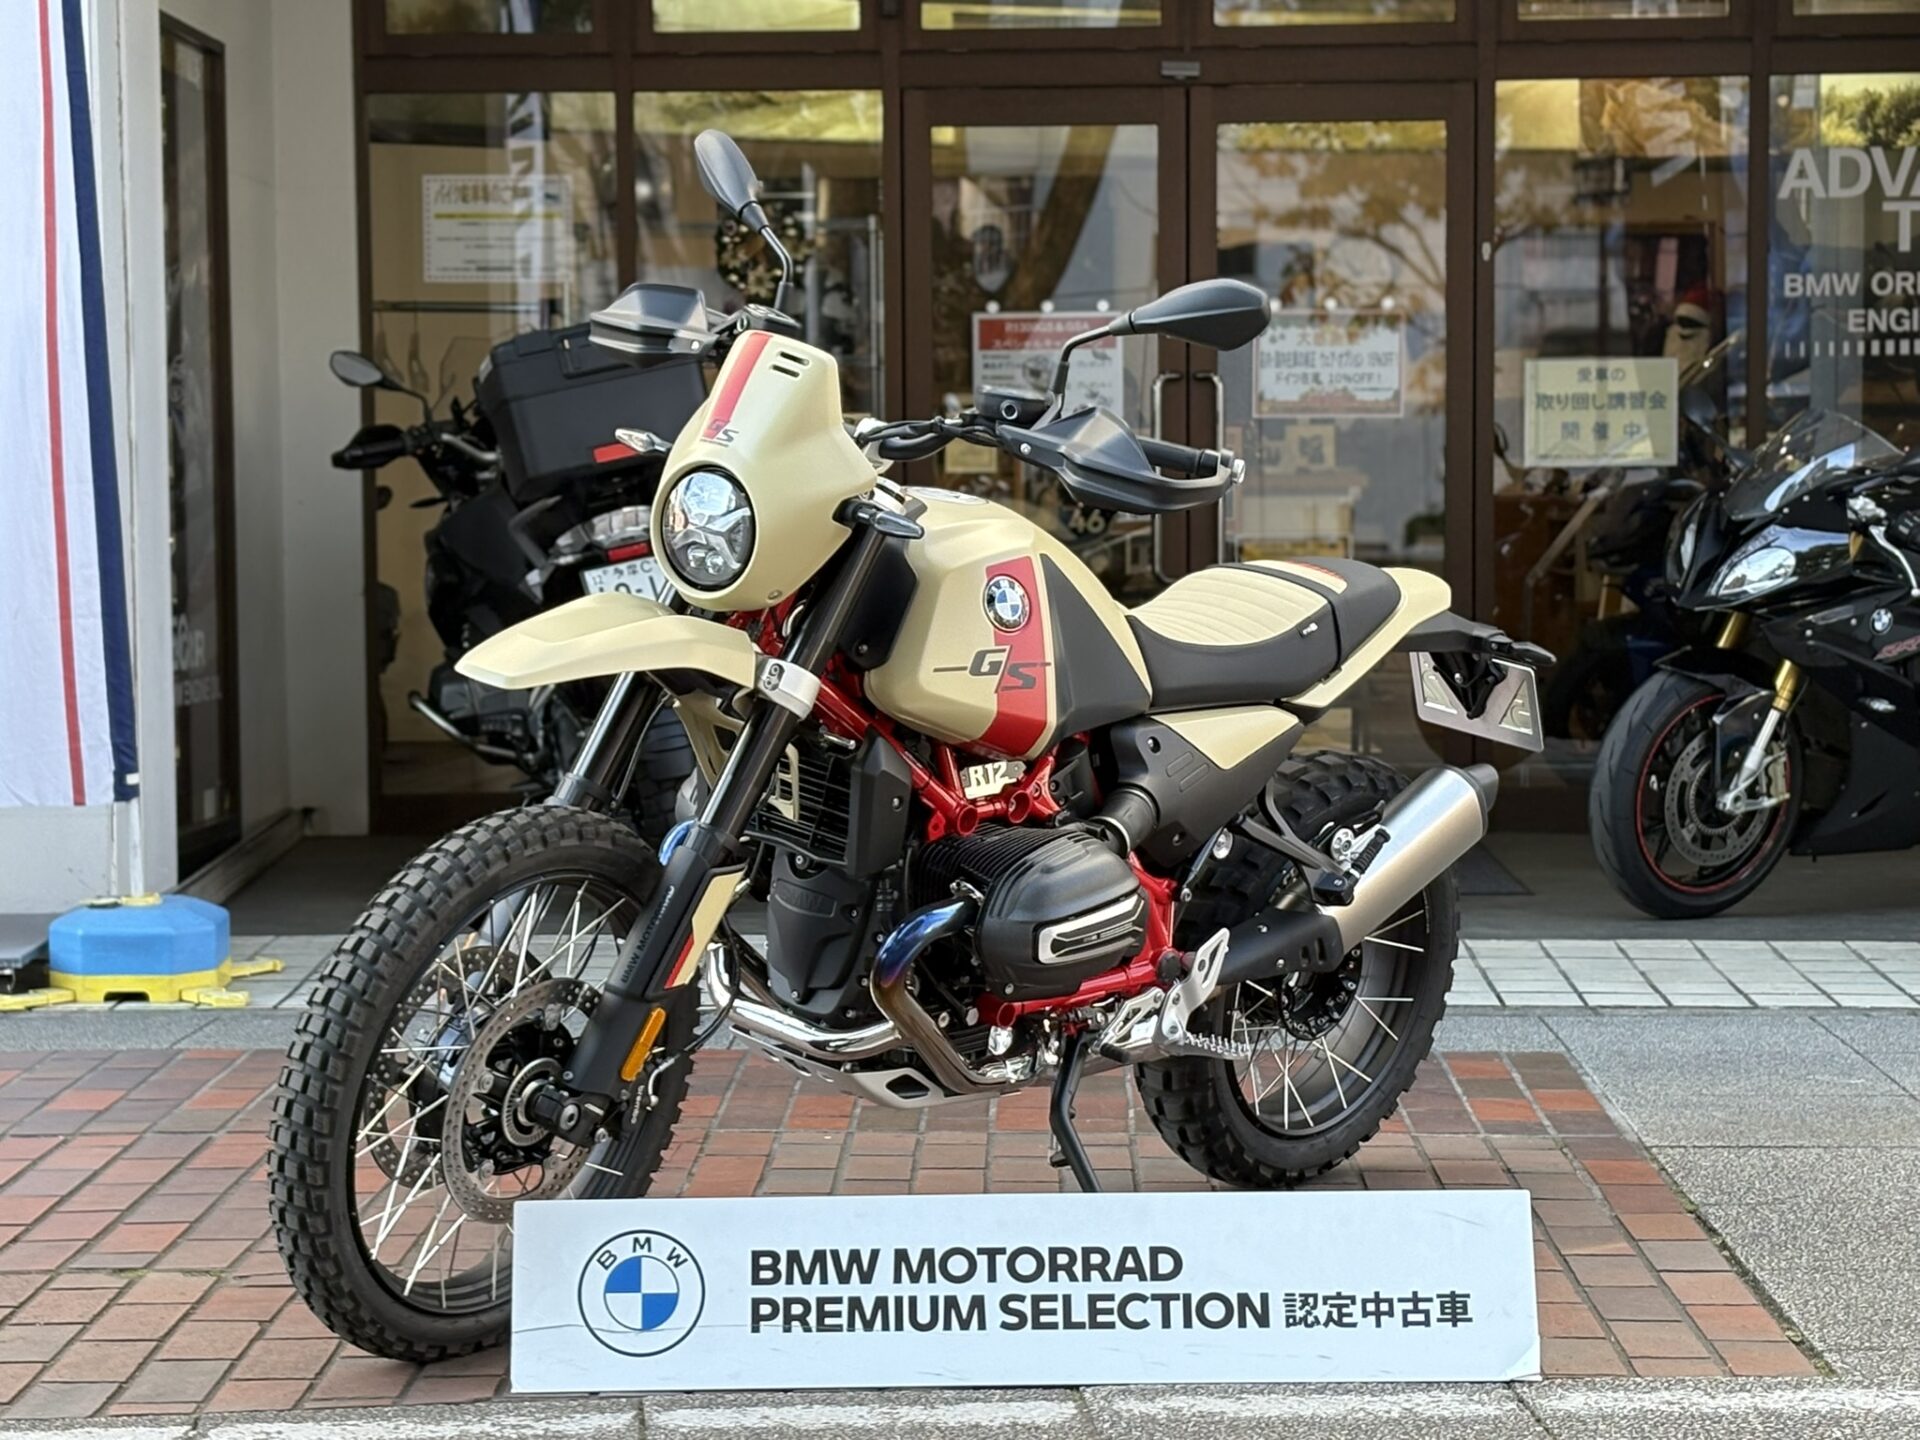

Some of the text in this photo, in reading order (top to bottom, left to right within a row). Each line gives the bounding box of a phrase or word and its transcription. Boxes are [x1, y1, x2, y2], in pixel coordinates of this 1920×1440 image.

[1778, 146, 1920, 198] ADV
[1784, 272, 1860, 298] BMW
[1848, 307, 1919, 333] ENGI
[596, 1236, 689, 1271] BMW
[752, 1246, 1183, 1286] BMW MOTORRAD
[751, 1290, 1473, 1334] PREMIUM SELECTION 認定中古車
